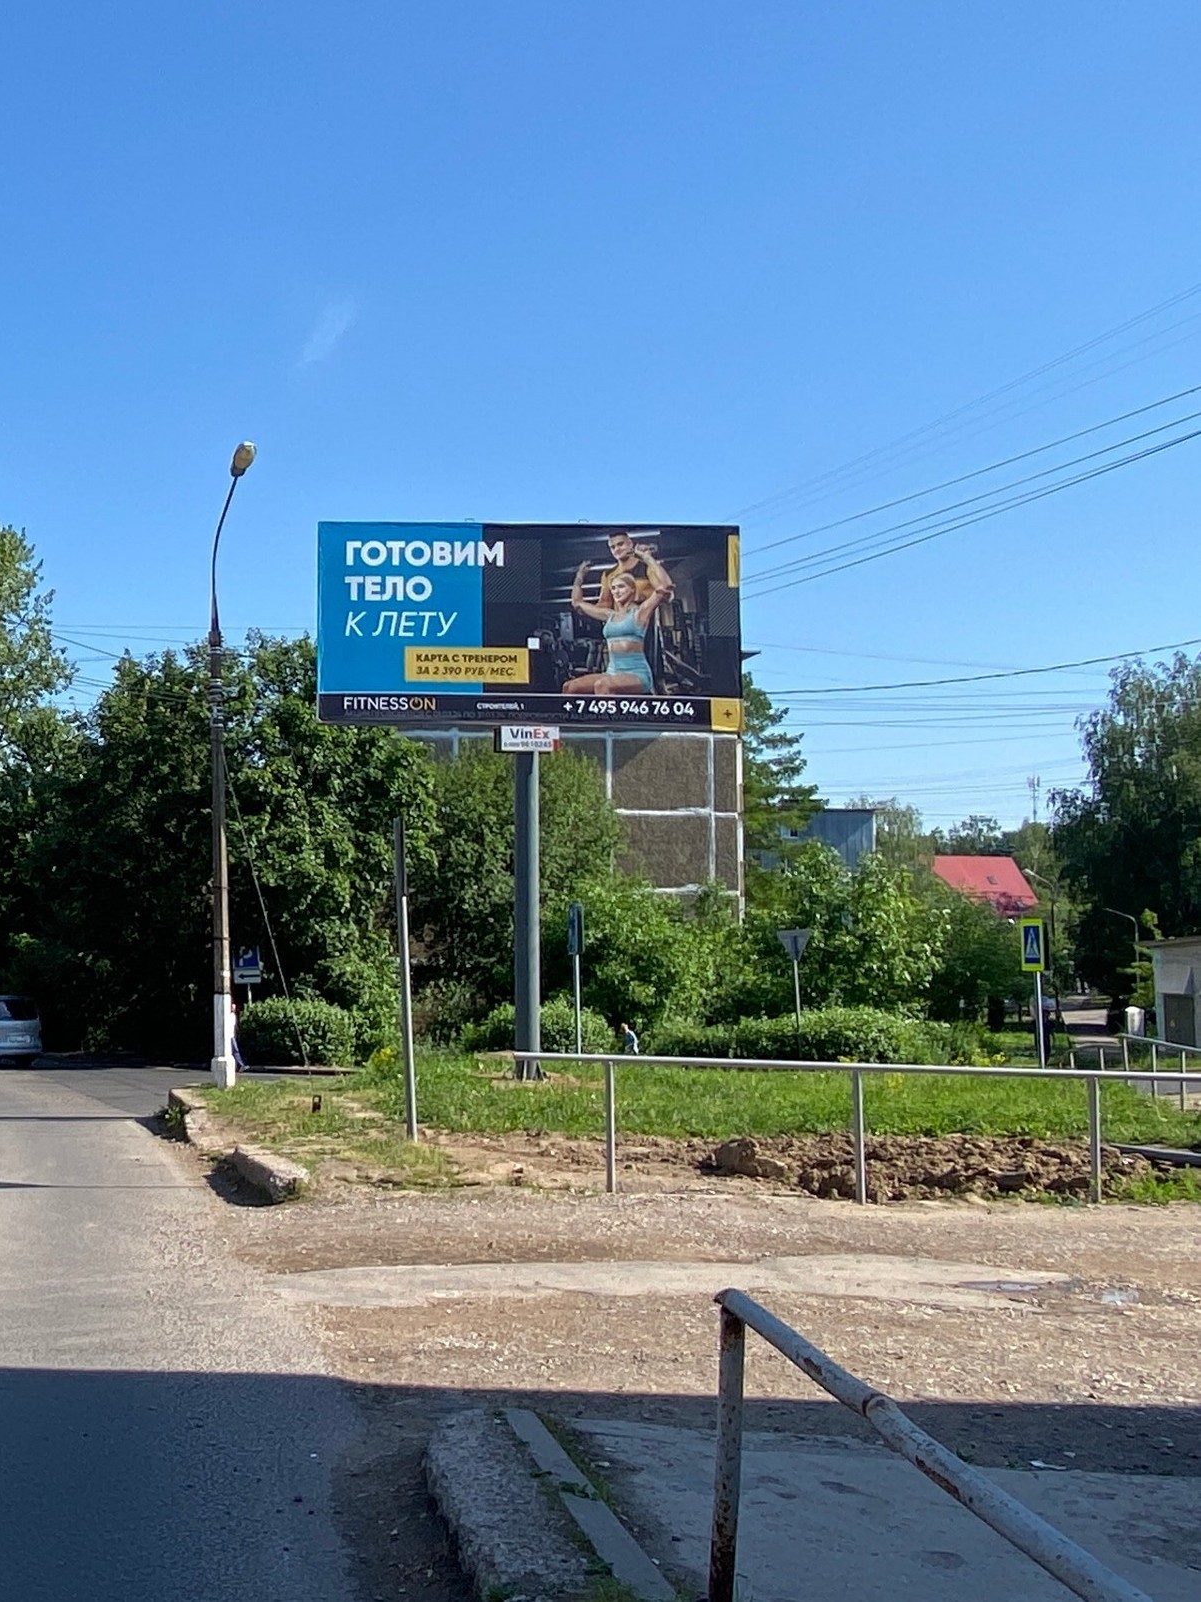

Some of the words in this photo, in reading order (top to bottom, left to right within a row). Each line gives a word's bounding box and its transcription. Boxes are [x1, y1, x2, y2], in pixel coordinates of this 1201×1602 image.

[346, 541, 504, 566] ГОТОВИМ
[345, 575, 432, 601] ТЕЛО
[345, 611, 366, 636] К
[372, 611, 458, 636] ЛЕТУ
[416, 653, 449, 663] КАРТА
[452, 654, 460, 663] С
[462, 654, 517, 663] ТРЕНЕРОМ
[416, 666, 430, 675] ЗА
[432, 667, 439, 675] 2
[442, 667, 462, 676] 390
[464, 667, 516, 676] РУБ/МЕС.
[343, 696, 436, 711] FITNESSON
[588, 700, 617, 714] 495
[620, 701, 648, 715] 946
[652, 701, 670, 715] 76
[673, 702, 695, 716] 04
[509, 727, 550, 739] VinEx
